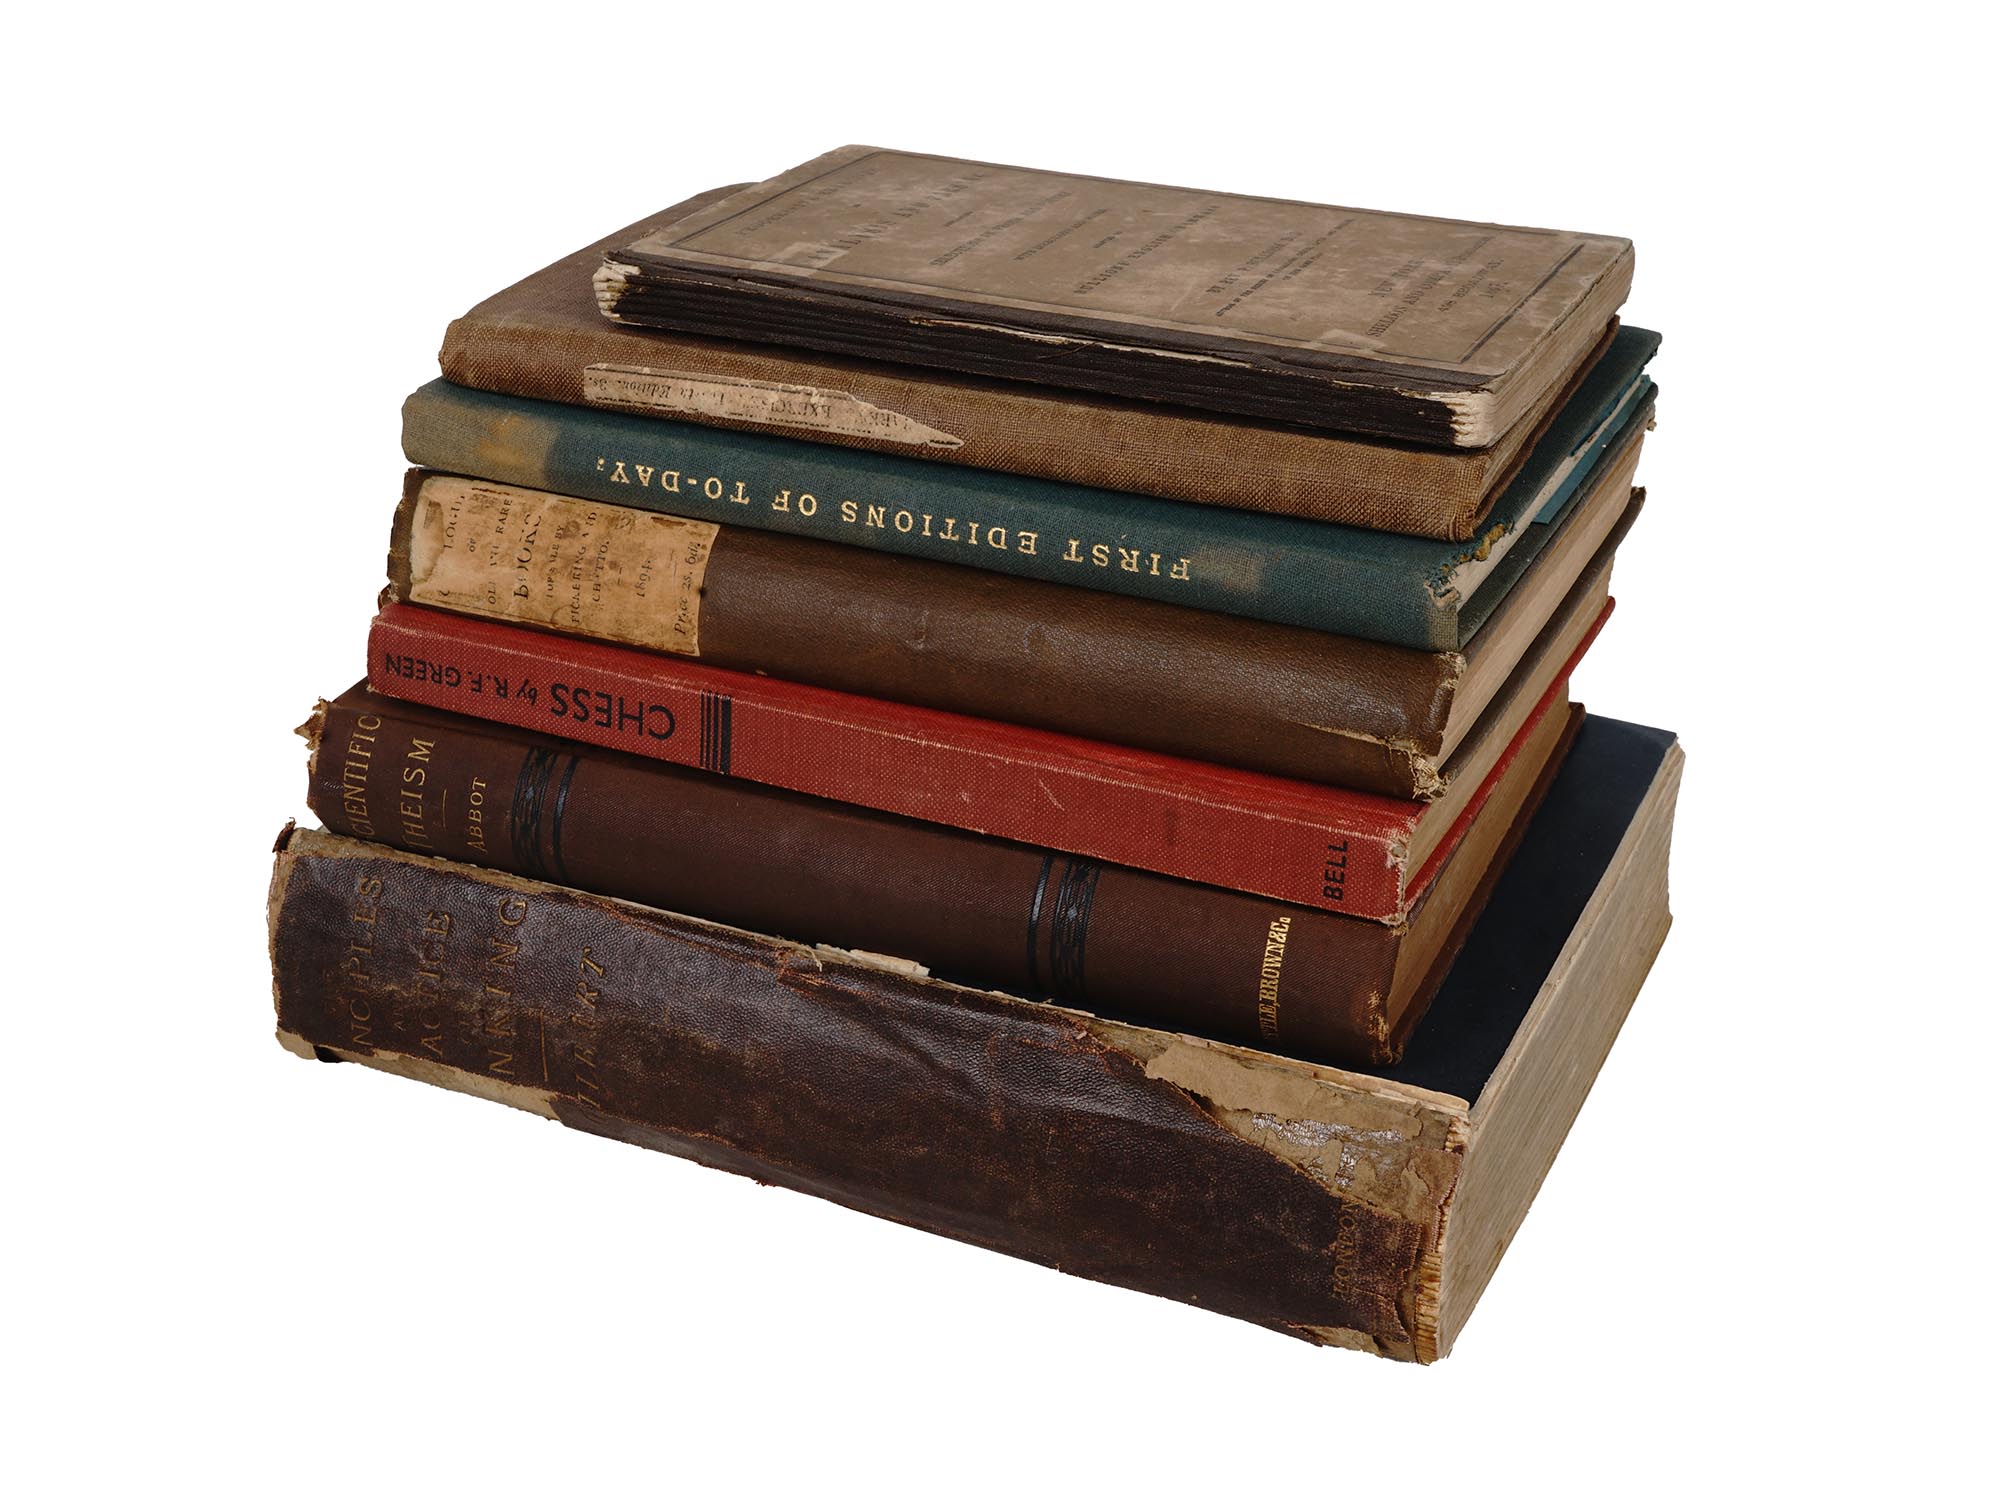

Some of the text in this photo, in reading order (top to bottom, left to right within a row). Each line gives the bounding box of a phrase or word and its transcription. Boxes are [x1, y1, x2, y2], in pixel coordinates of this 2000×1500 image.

[494, 499, 512, 535] RARE
[772, 487, 819, 518] OF
[837, 499, 1039, 556] EDITIONS
[1061, 538, 1191, 582] FIRST
[385, 653, 461, 688] GREEN
[516, 678, 538, 706] by
[550, 684, 676, 742] CHESS
[466, 776, 489, 853] ABBOT
[1322, 840, 1349, 902] BELL
